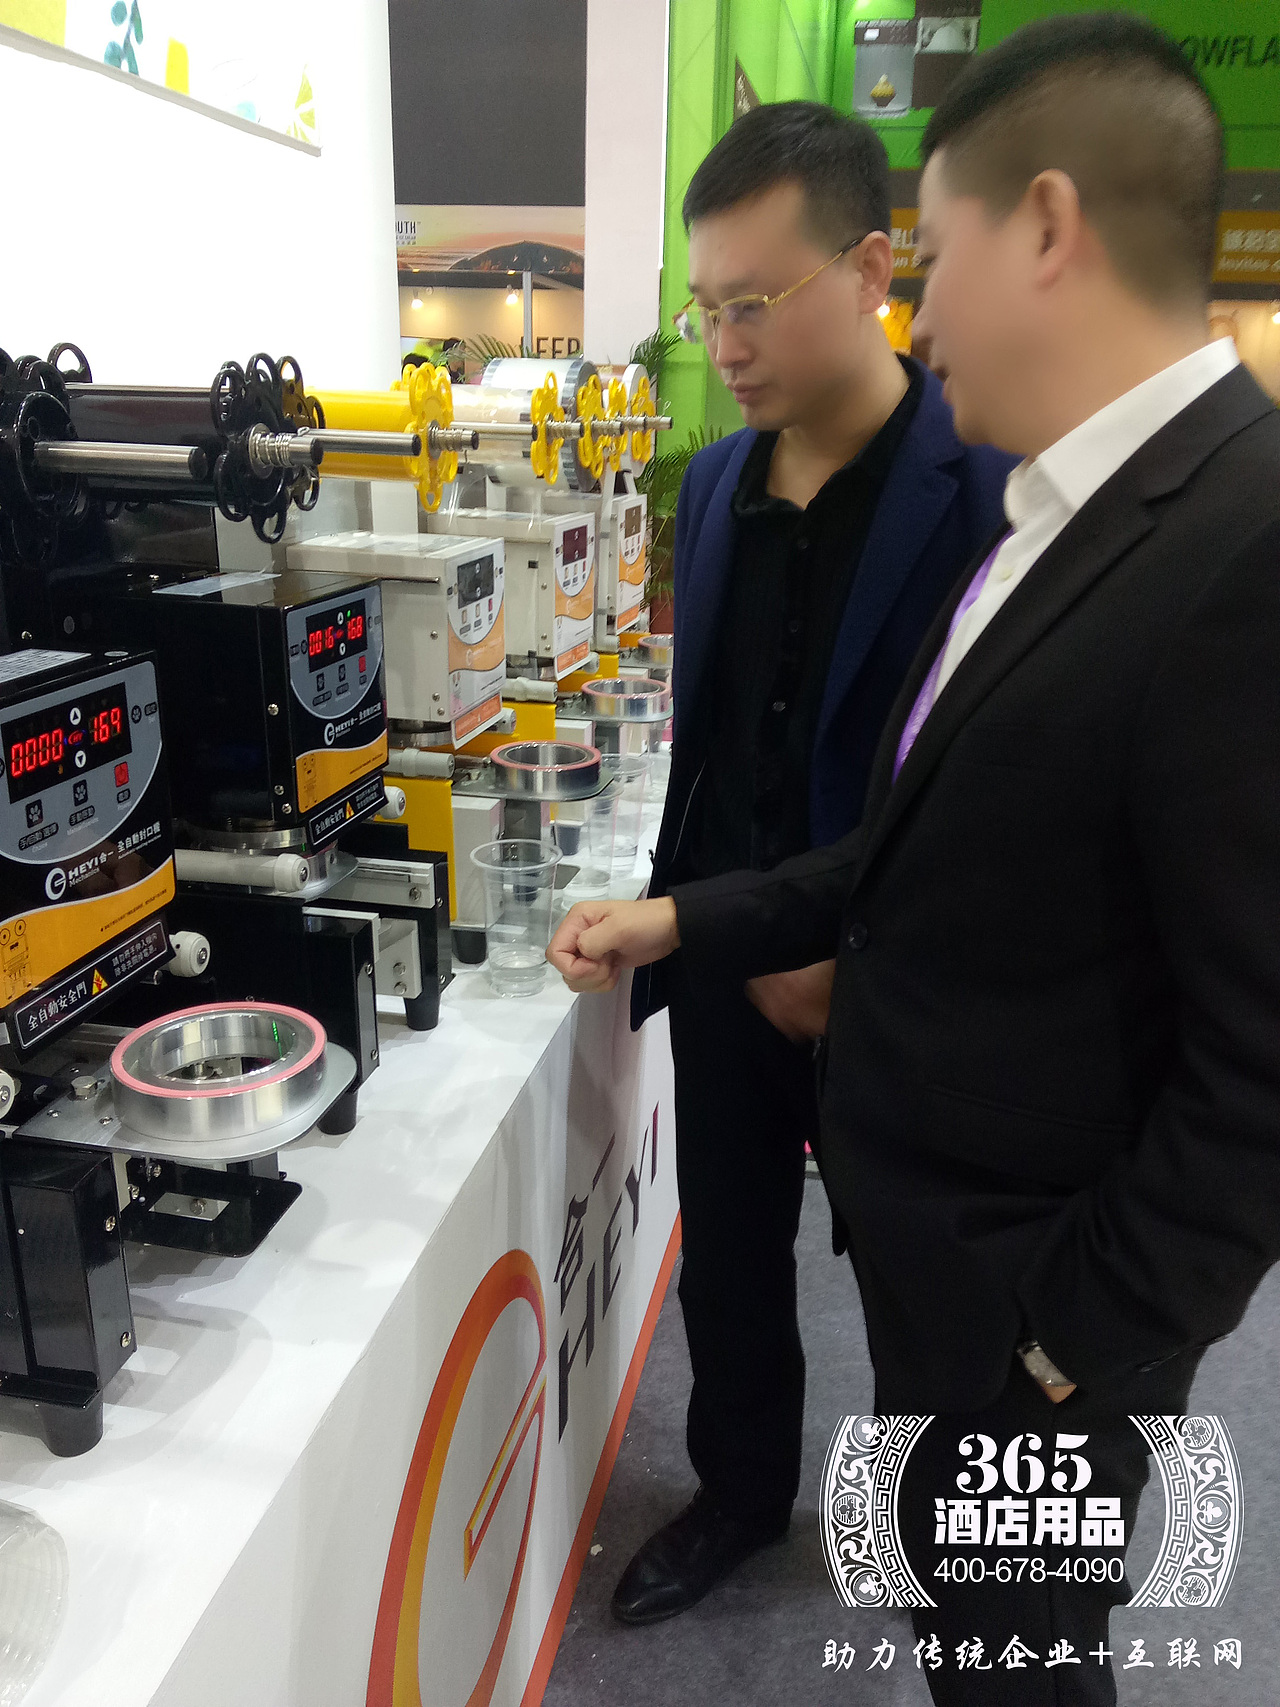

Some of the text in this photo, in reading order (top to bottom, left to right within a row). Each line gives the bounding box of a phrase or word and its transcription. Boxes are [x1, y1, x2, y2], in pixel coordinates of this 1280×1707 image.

[395, 221, 416, 234] UTH
[347, 616, 363, 640] 168
[11, 728, 64, 778] 0000
[93, 707, 121, 744] 169
[68, 857, 98, 880] HEYI
[28, 981, 87, 1031] 全自動安全門
[558, 1101, 660, 1445] HEYI
